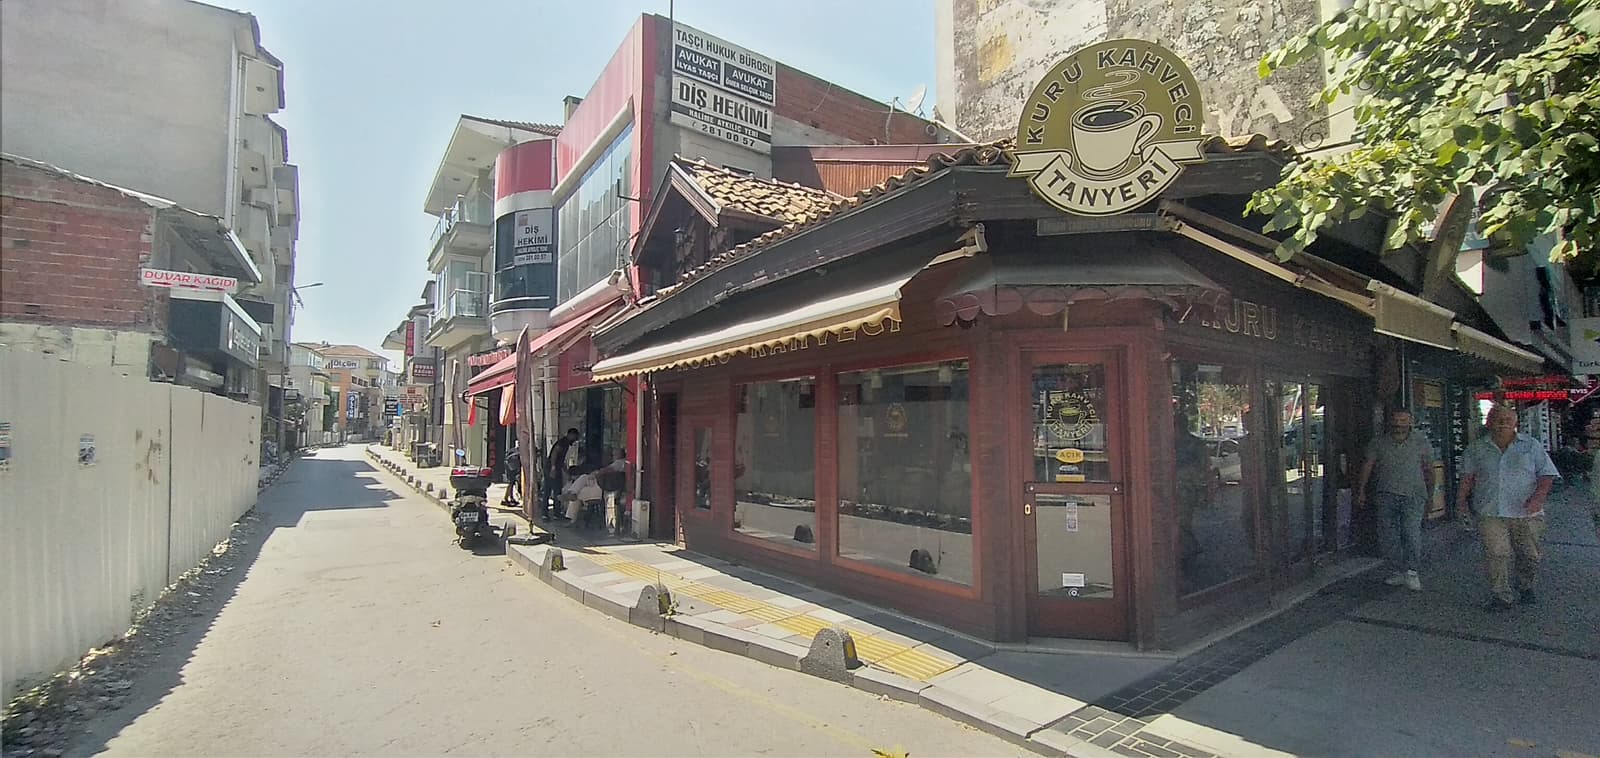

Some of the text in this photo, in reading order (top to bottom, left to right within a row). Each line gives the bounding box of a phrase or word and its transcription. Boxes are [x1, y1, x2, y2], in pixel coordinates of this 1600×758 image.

[675, 29, 773, 76] TAŞÇI HUKUK BÜROSU
[678, 50, 718, 71] AVUKAT
[676, 61, 719, 81] İLYAS TAŞÇI
[732, 70, 768, 89] AVUKAT
[679, 82, 768, 130] DİŞ HEKİMİ
[1026, 47, 1195, 145] KURU KAHVECİ
[702, 123, 755, 148] 281 00 57
[1047, 160, 1169, 207] TANYERİ
[518, 235, 547, 245] HEKİMİ
[144, 271, 190, 283] DUVAR
